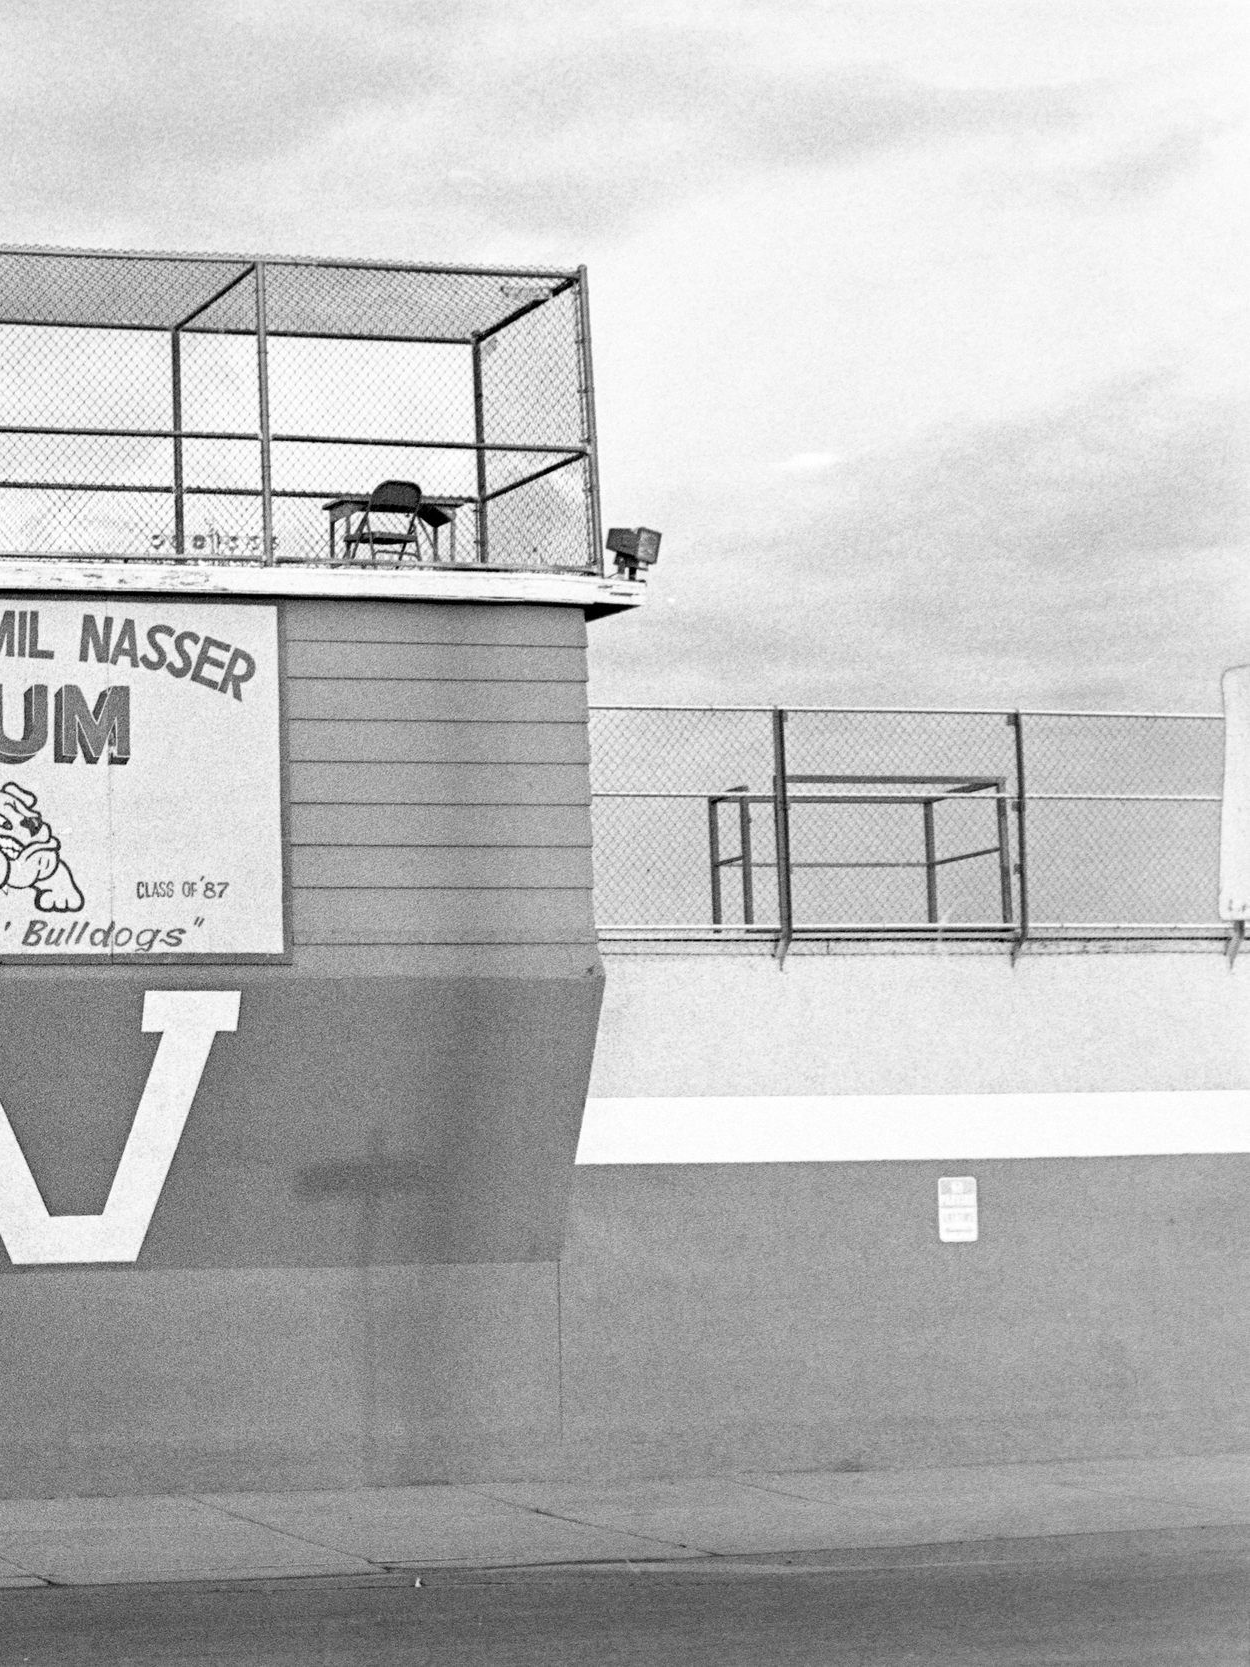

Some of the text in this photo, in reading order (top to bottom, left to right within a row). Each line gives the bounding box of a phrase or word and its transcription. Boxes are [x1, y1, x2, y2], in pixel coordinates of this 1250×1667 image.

[79, 614, 256, 701] NASSER
[136, 876, 230, 900] CLASS OF '87
[22, 917, 205, 953] Bulldogs"
